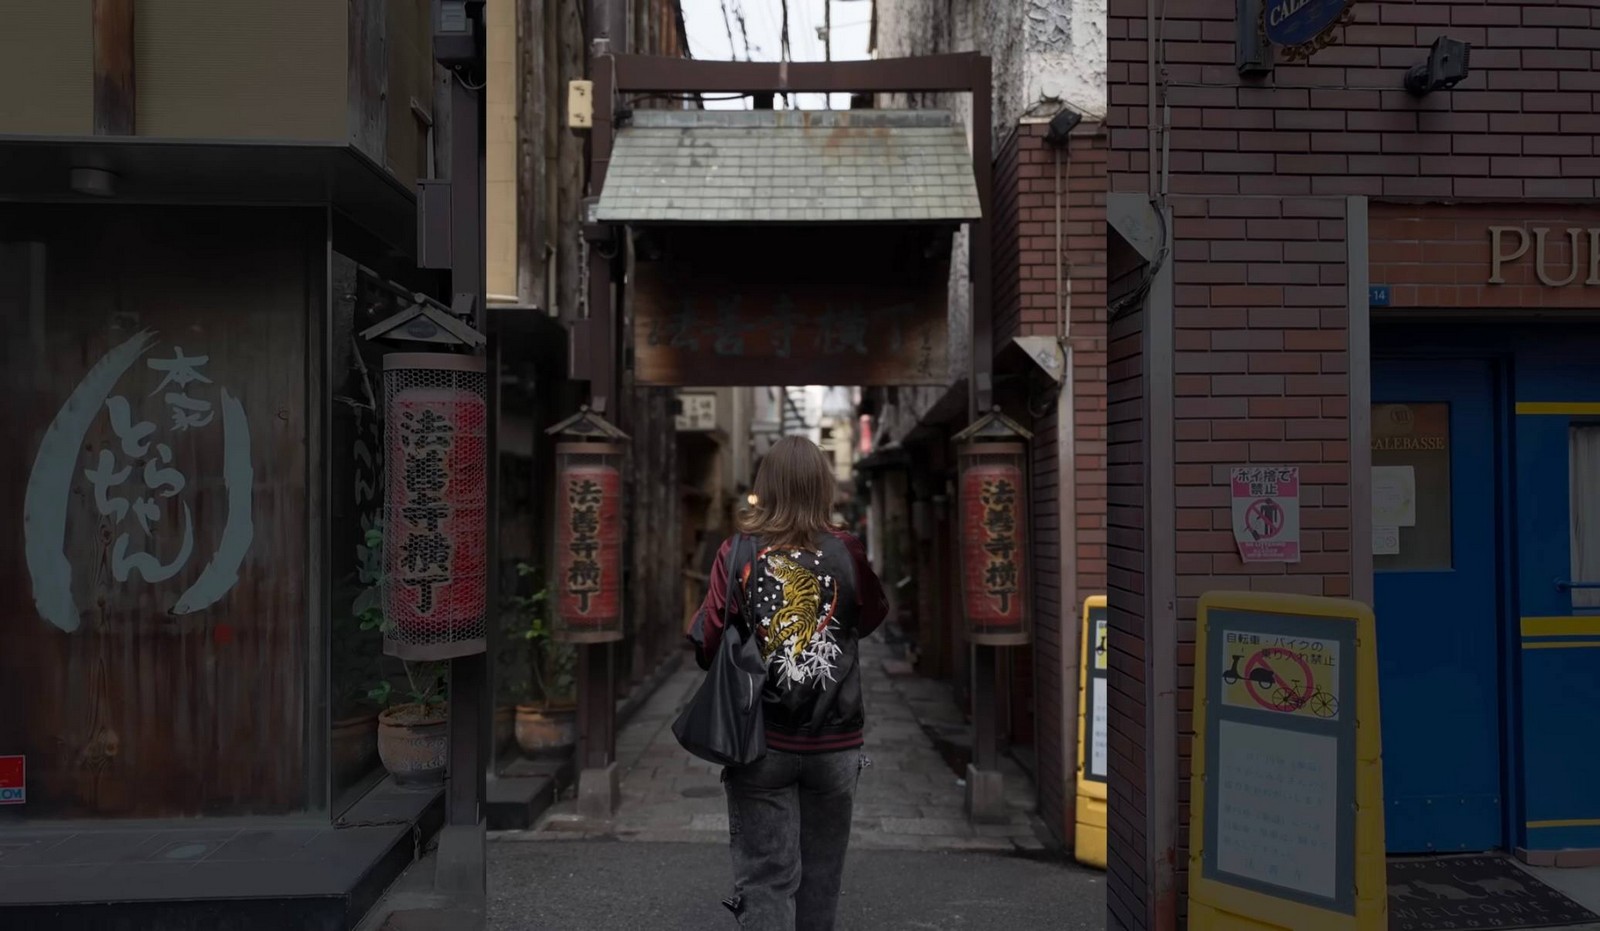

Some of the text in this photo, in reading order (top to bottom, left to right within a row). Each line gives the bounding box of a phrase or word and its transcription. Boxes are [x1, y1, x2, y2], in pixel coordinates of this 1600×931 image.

[1370, 437, 1446, 450] ALEBASSE
[1251, 483, 1276, 495] 禁止
[569, 479, 602, 613] 法善寺横丁
[982, 479, 1016, 613] 法善寺横丁
